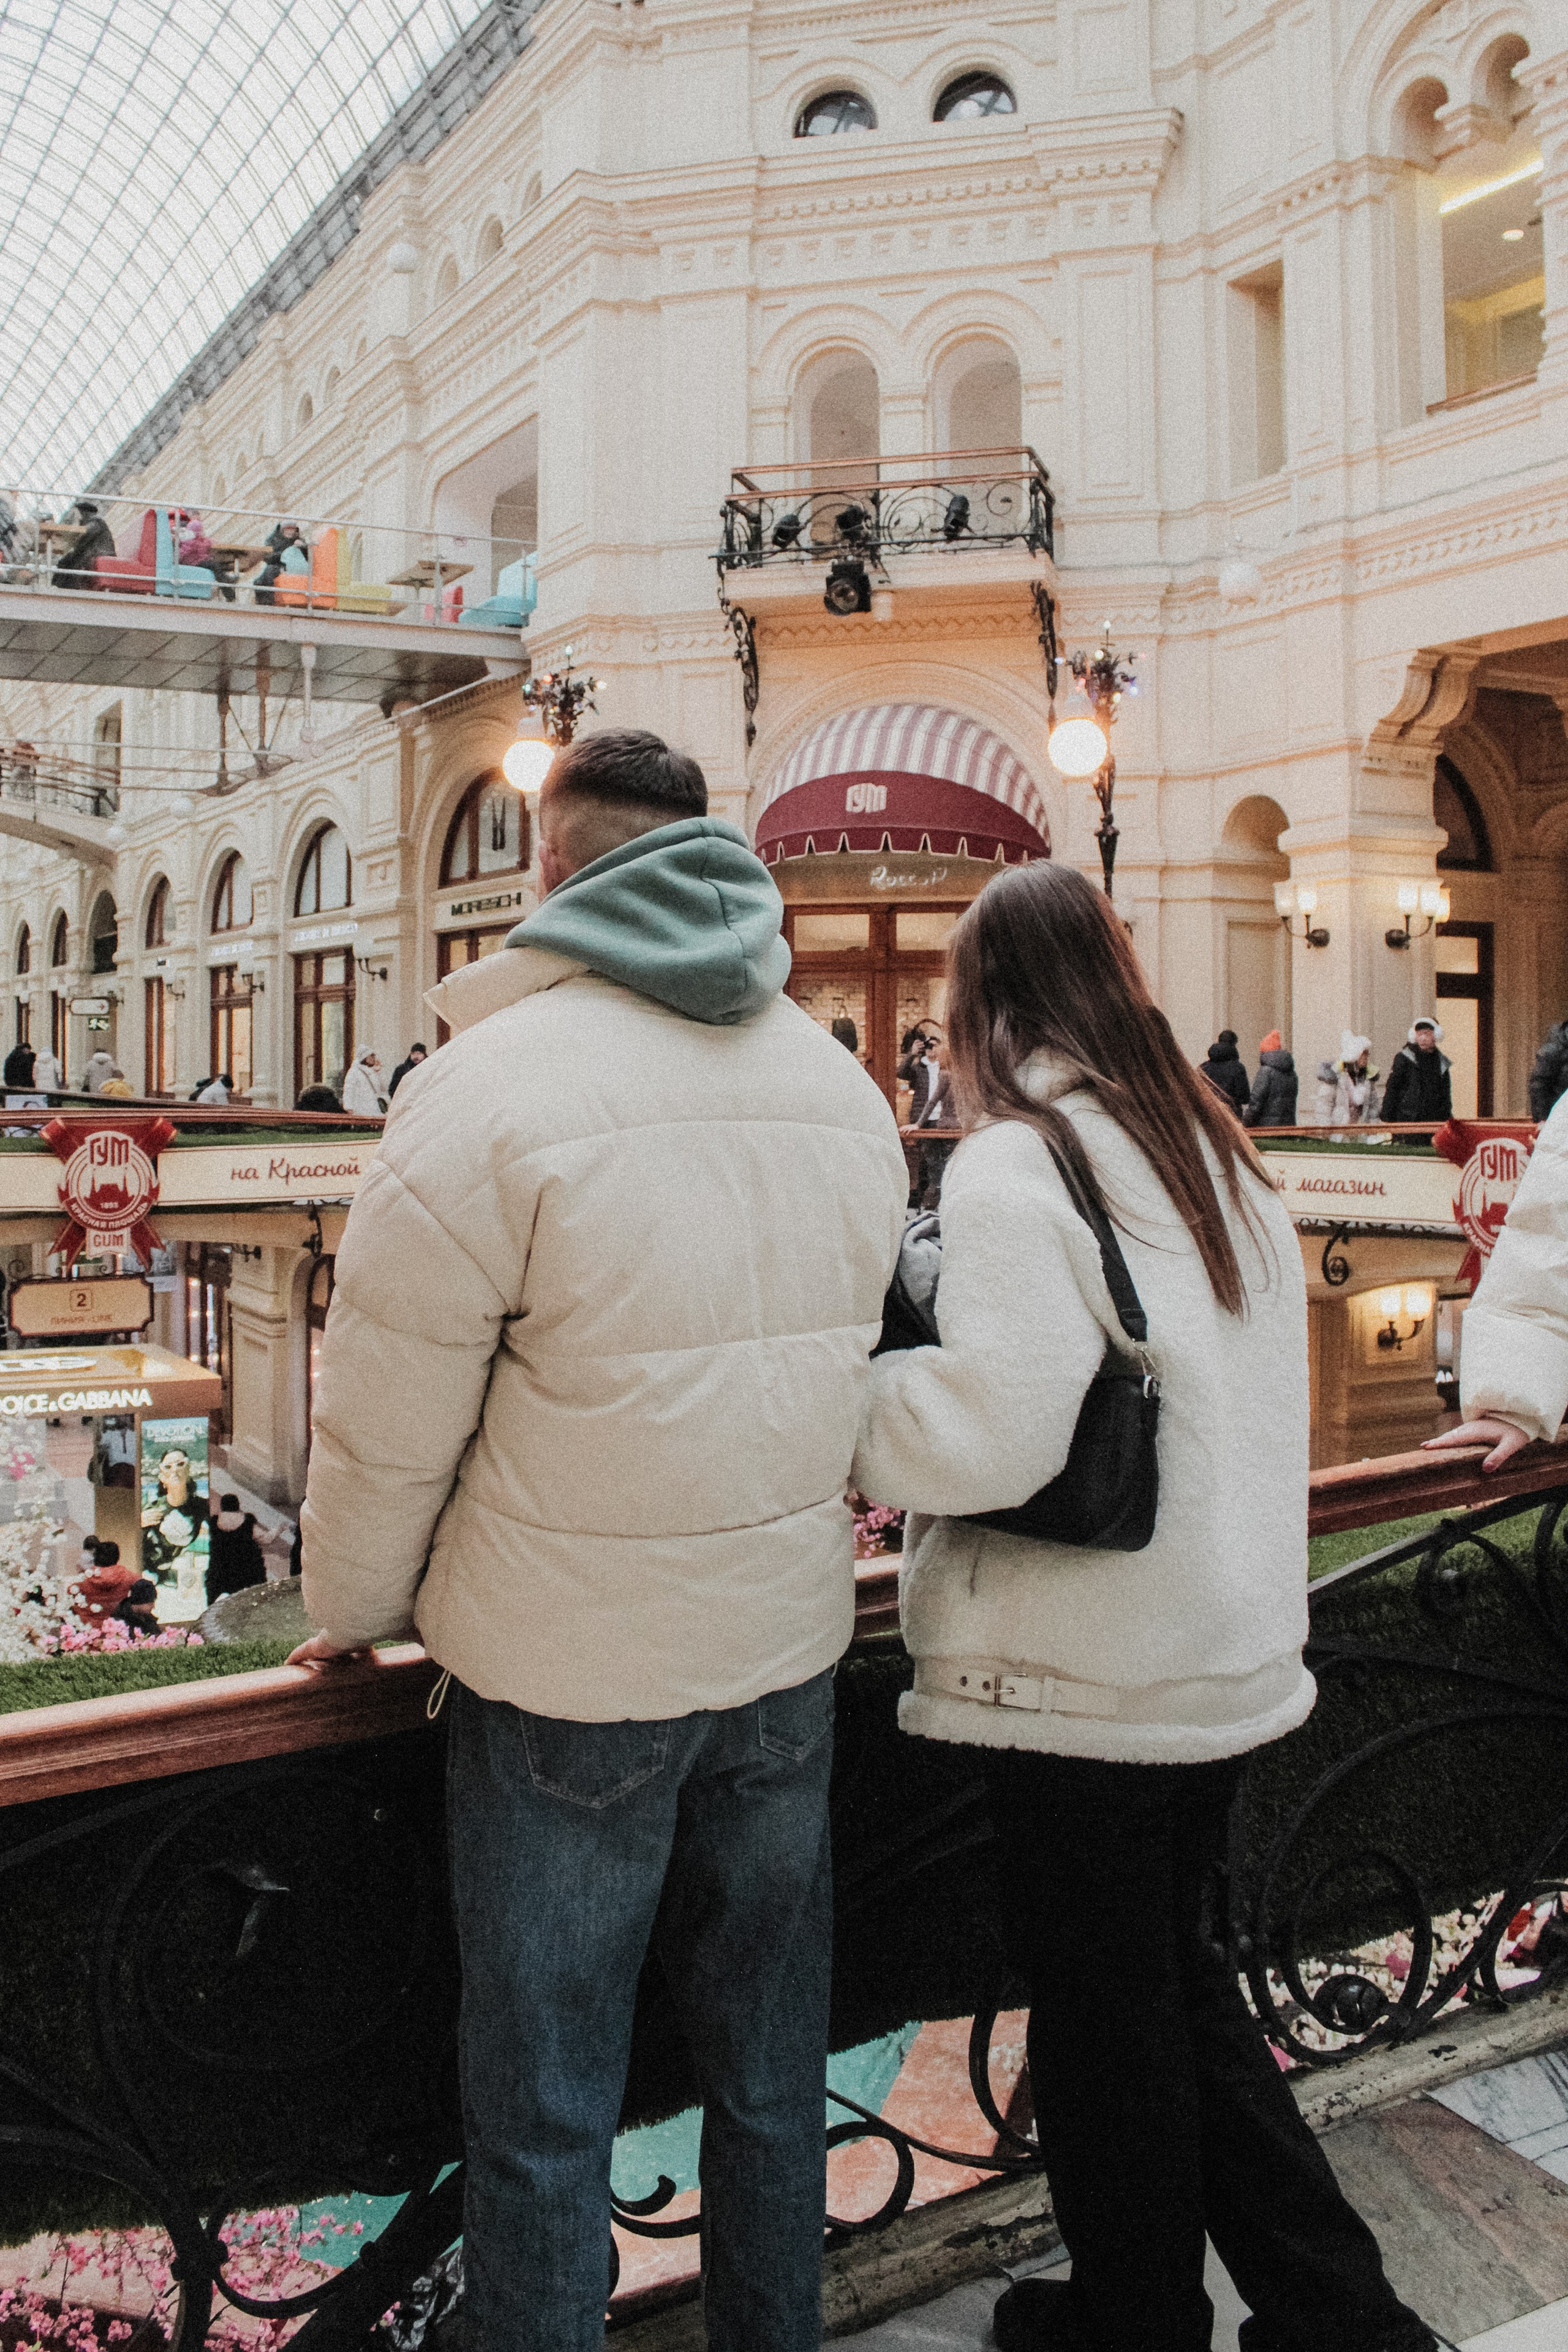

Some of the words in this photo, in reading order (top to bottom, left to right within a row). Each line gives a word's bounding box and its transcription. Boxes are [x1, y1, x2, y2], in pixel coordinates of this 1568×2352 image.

[845, 782, 888, 813] ГУМ
[90, 1136, 129, 1167] ГУМ
[1480, 1144, 1518, 1182] ГУМ
[230, 1167, 260, 1181] на
[268, 1157, 361, 1186] Красной
[1295, 1177, 1387, 1197] магазин
[93, 1234, 124, 1247] GUM
[1463, 1223, 1491, 1254] КРАСНА
[77, 1293, 86, 1307] 2
[0, 1388, 153, 1415] OLCE&GABBANA
